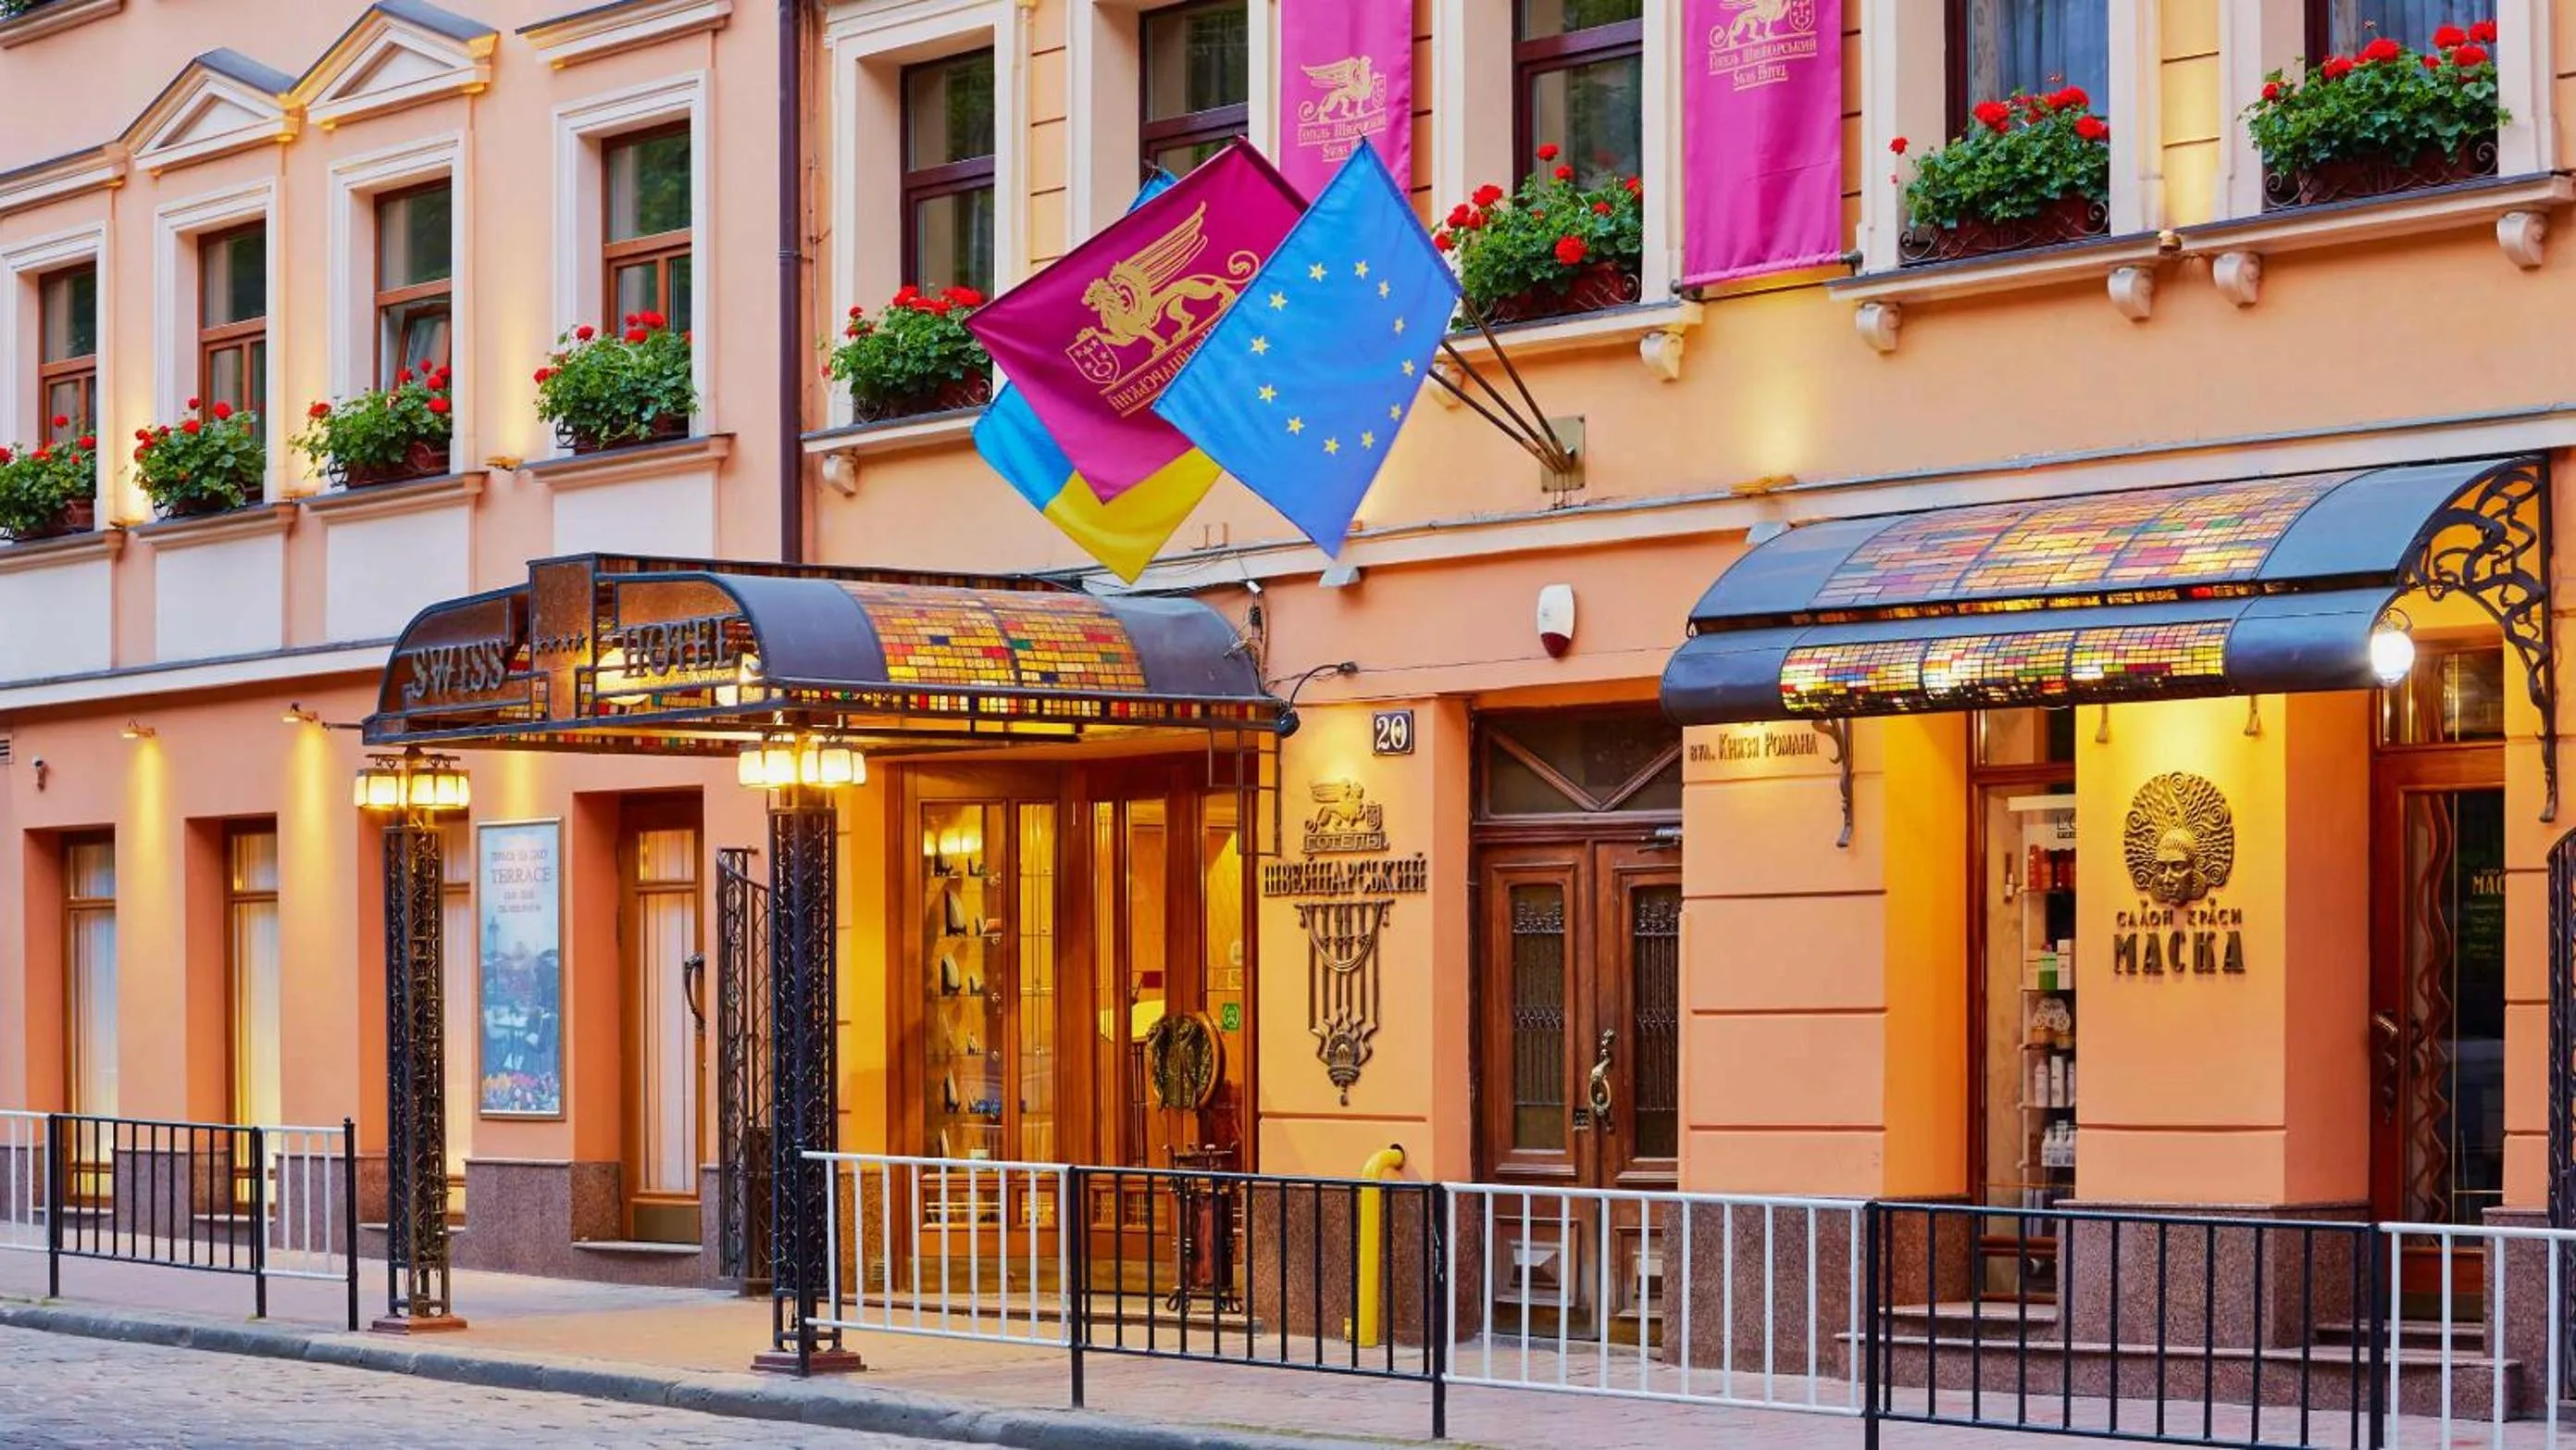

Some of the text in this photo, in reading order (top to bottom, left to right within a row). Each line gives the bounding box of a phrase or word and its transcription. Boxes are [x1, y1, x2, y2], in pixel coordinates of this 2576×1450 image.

[412, 615, 740, 698] SWISS HOTEL
[1375, 715, 1407, 750] 20
[1305, 834, 1381, 851] ГОТЕЛЬ
[490, 867, 552, 884] TERRACE
[2116, 907, 2243, 927] САЛОН КРАСИ
[2113, 931, 2246, 975] МАСКА
